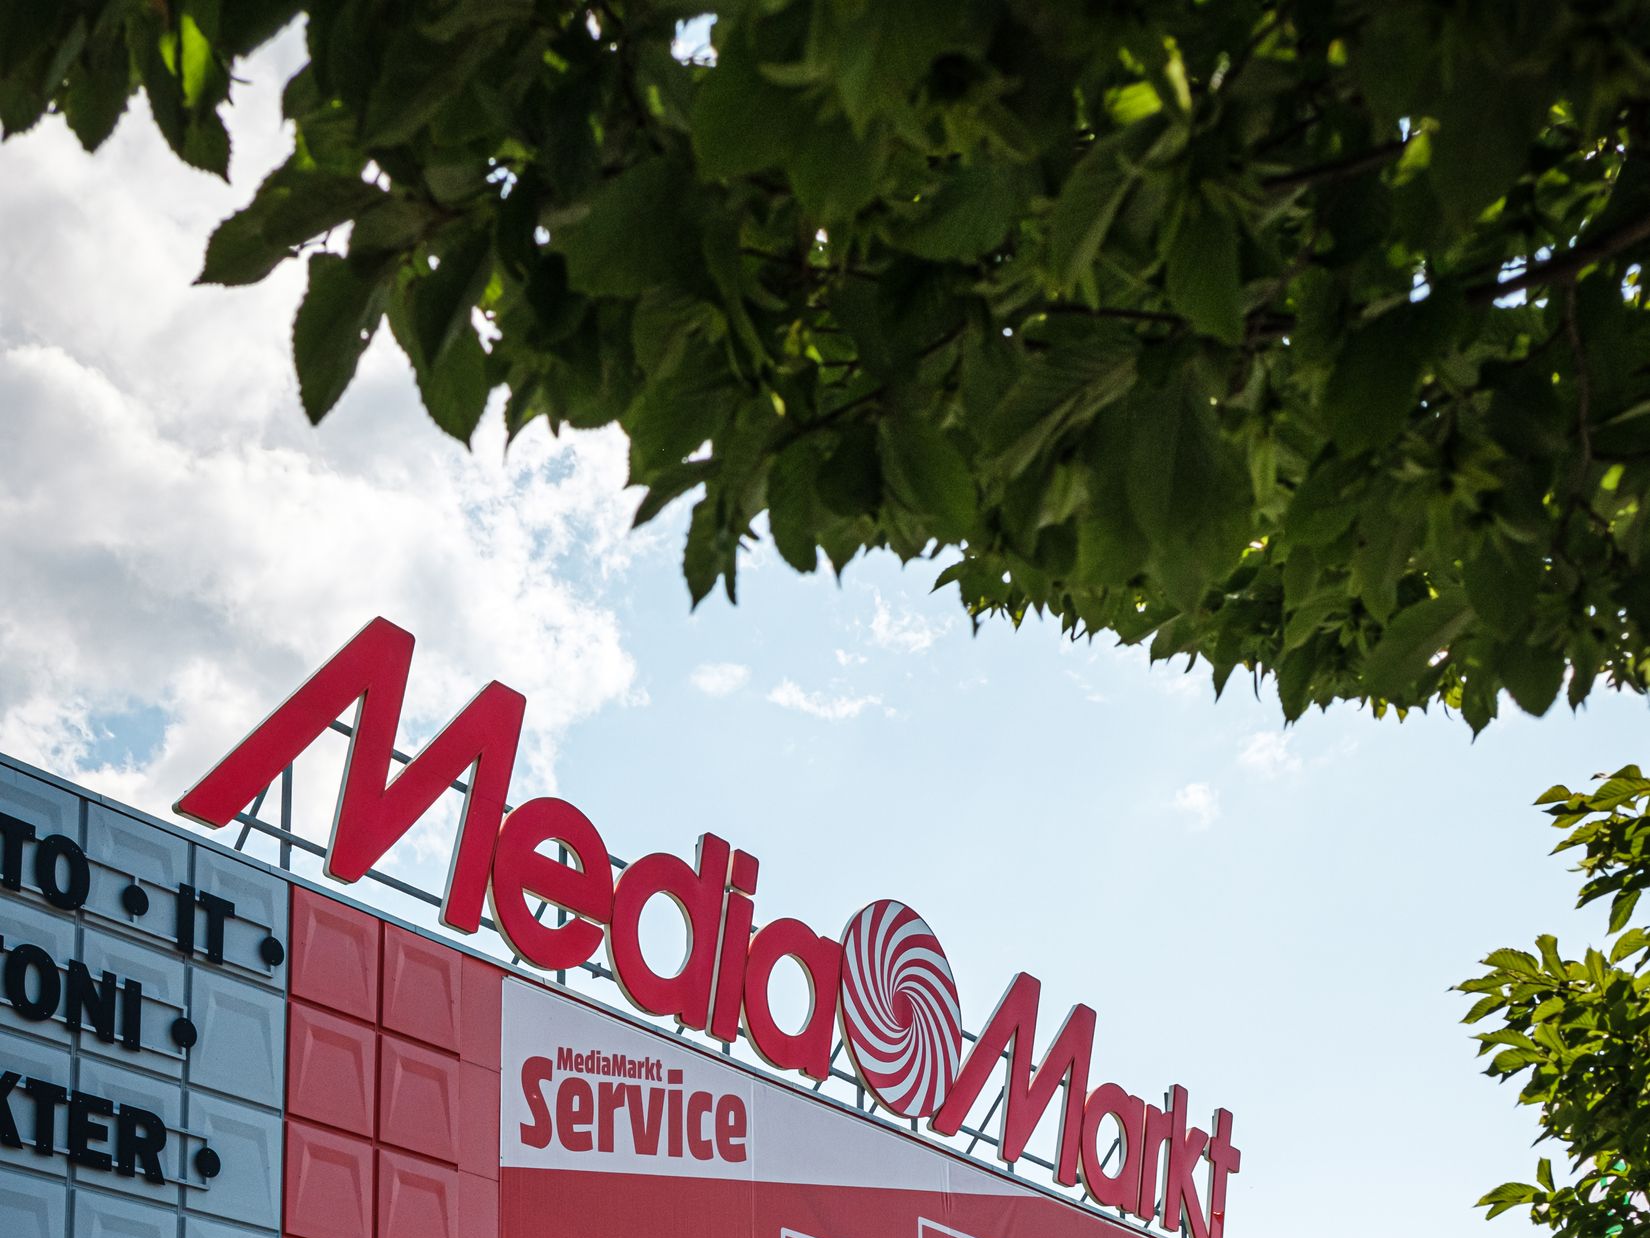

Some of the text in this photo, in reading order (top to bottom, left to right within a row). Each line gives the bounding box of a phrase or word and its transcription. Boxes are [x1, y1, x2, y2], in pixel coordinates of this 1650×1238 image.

[172, 616, 844, 1083] Media
[177, 882, 236, 965] IT
[0, 934, 143, 1052] ONI
[520, 1055, 748, 1163] Service
[557, 1046, 663, 1082] MediaMarkt
